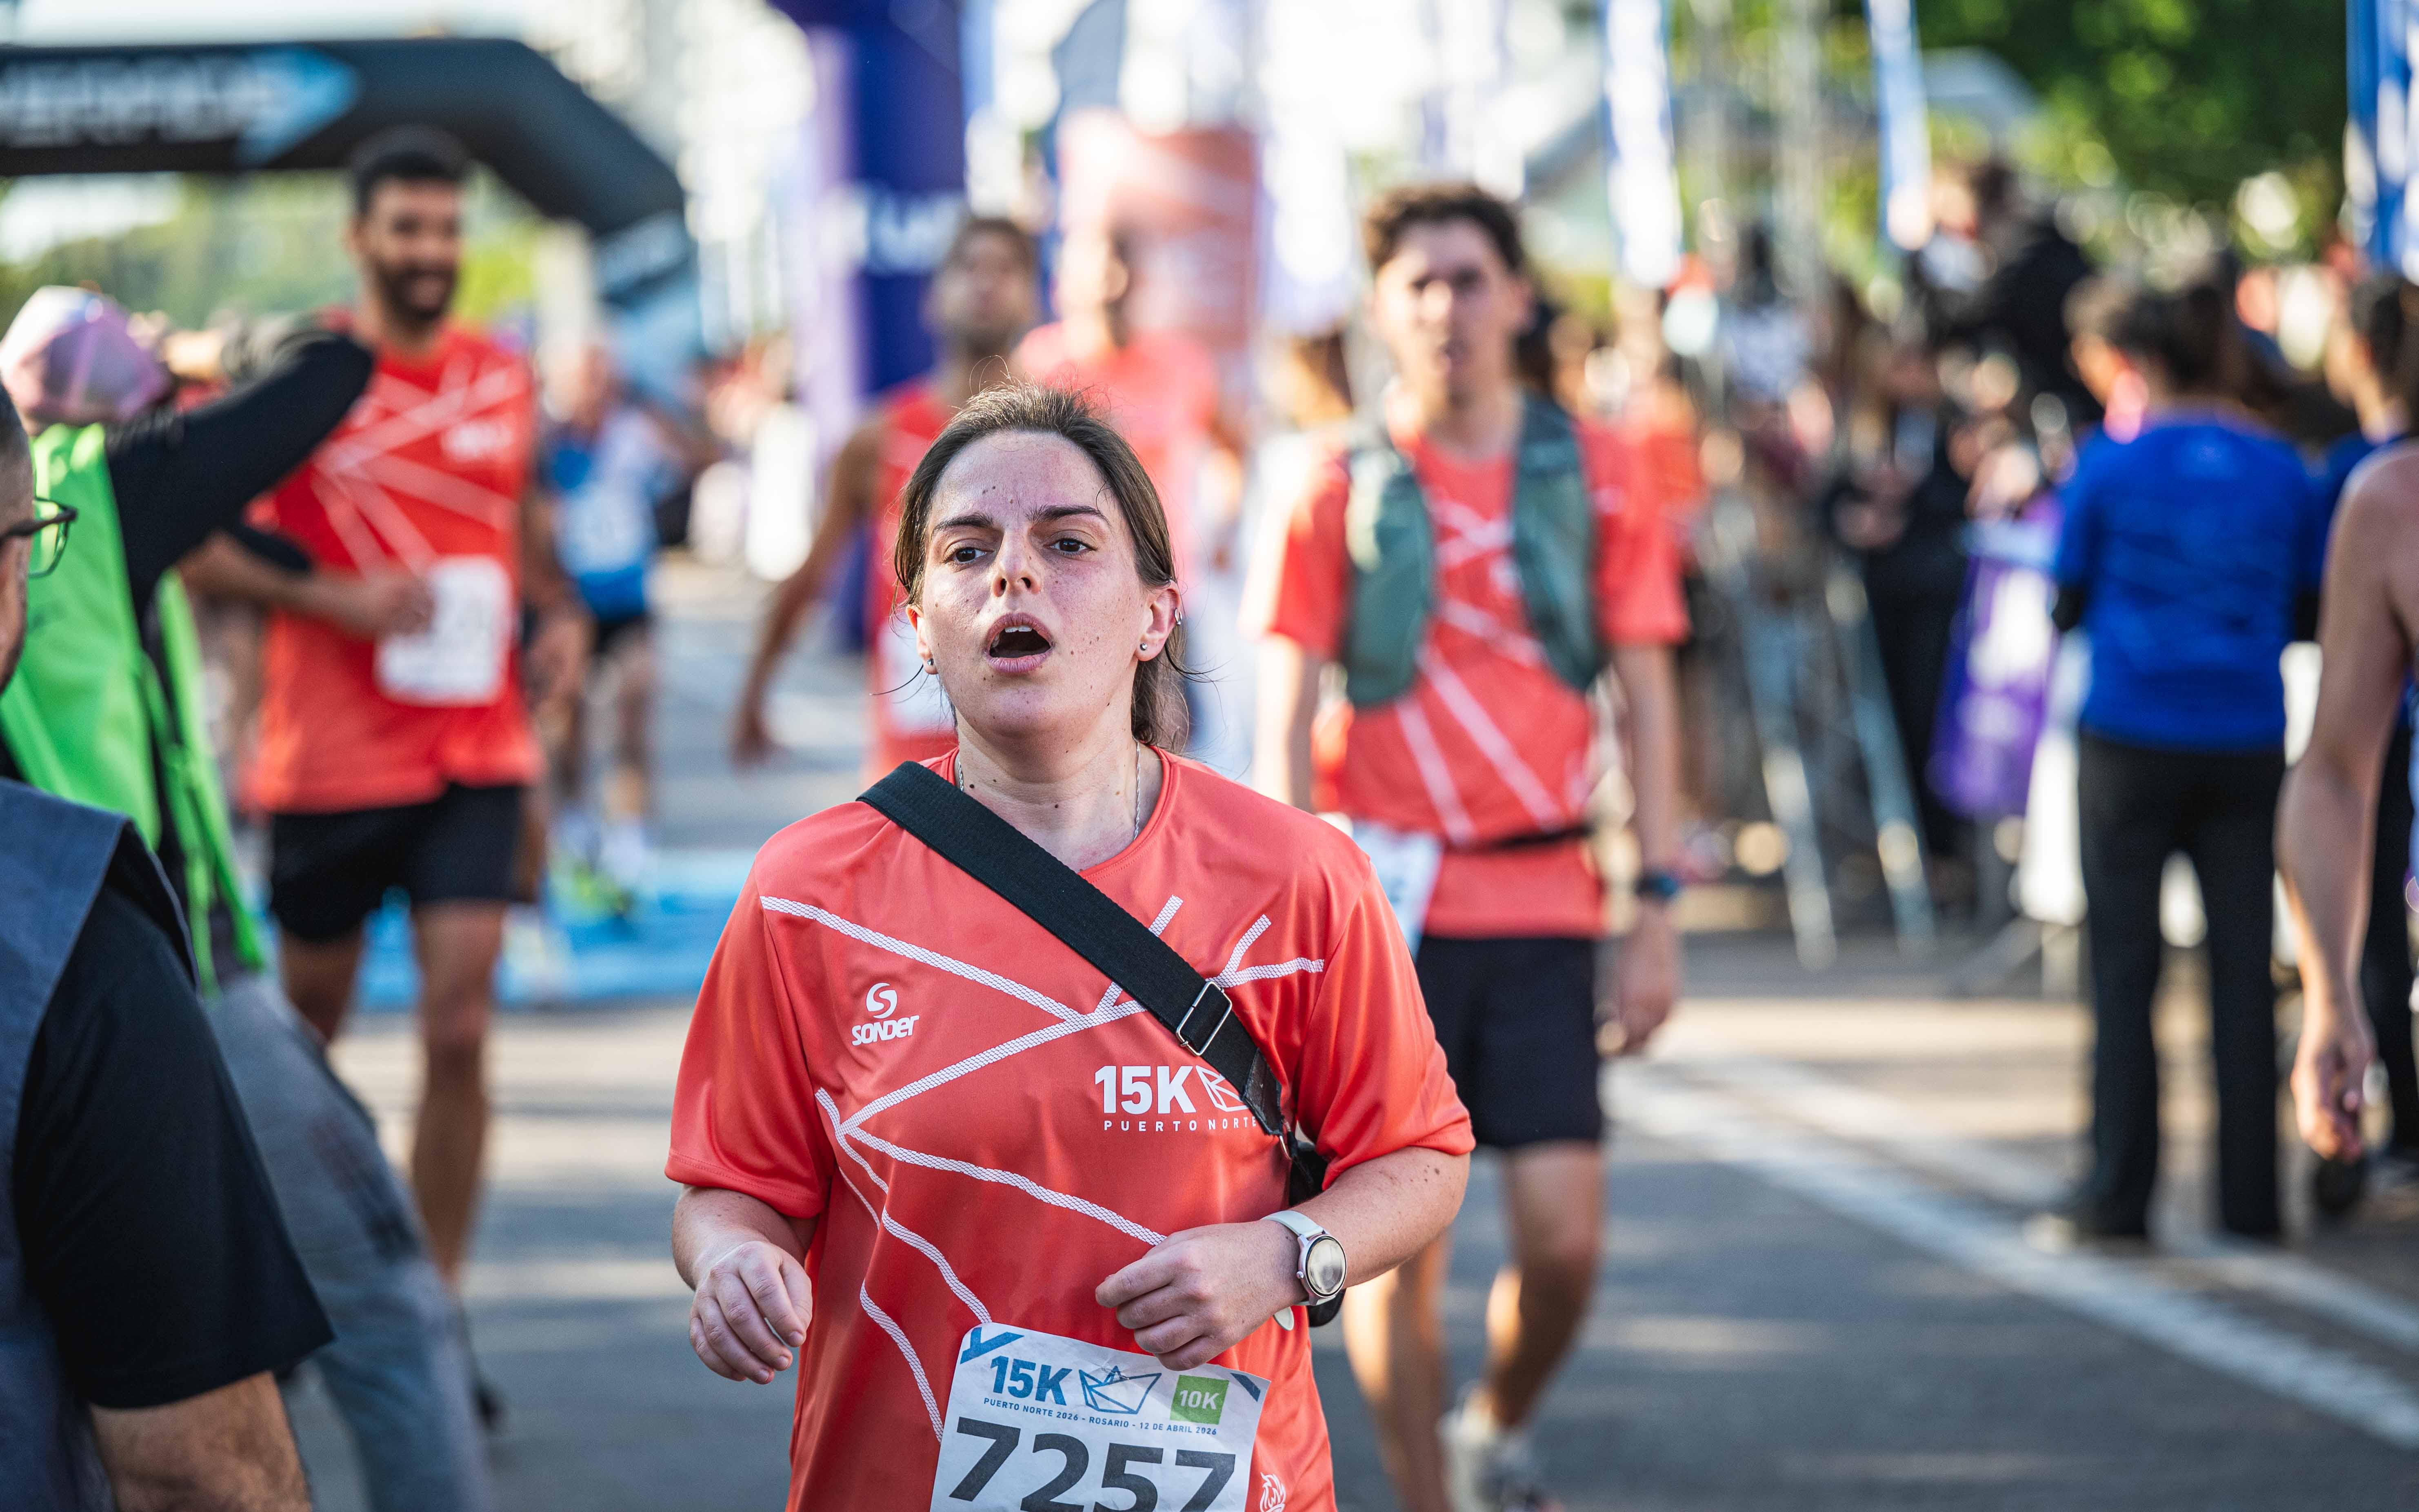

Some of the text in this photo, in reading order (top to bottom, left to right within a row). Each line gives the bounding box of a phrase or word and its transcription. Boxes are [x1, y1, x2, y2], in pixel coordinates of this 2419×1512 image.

[1094, 1065, 1197, 1115] 15K
[1104, 1116, 1257, 1132] PUERTO NORTE
[990, 1355, 1073, 1406] 15K
[1180, 1390, 1220, 1410] 10K
[984, 1397, 1020, 1410] PUERTO
[1022, 1405, 1053, 1417] NORTE
[1056, 1411, 1078, 1421] 2026
[1089, 1417, 1129, 1428] ROSARIO
[1166, 1424, 1193, 1433] ABRIL
[1196, 1427, 1217, 1435] 2026
[948, 1416, 1236, 1512] 7257
